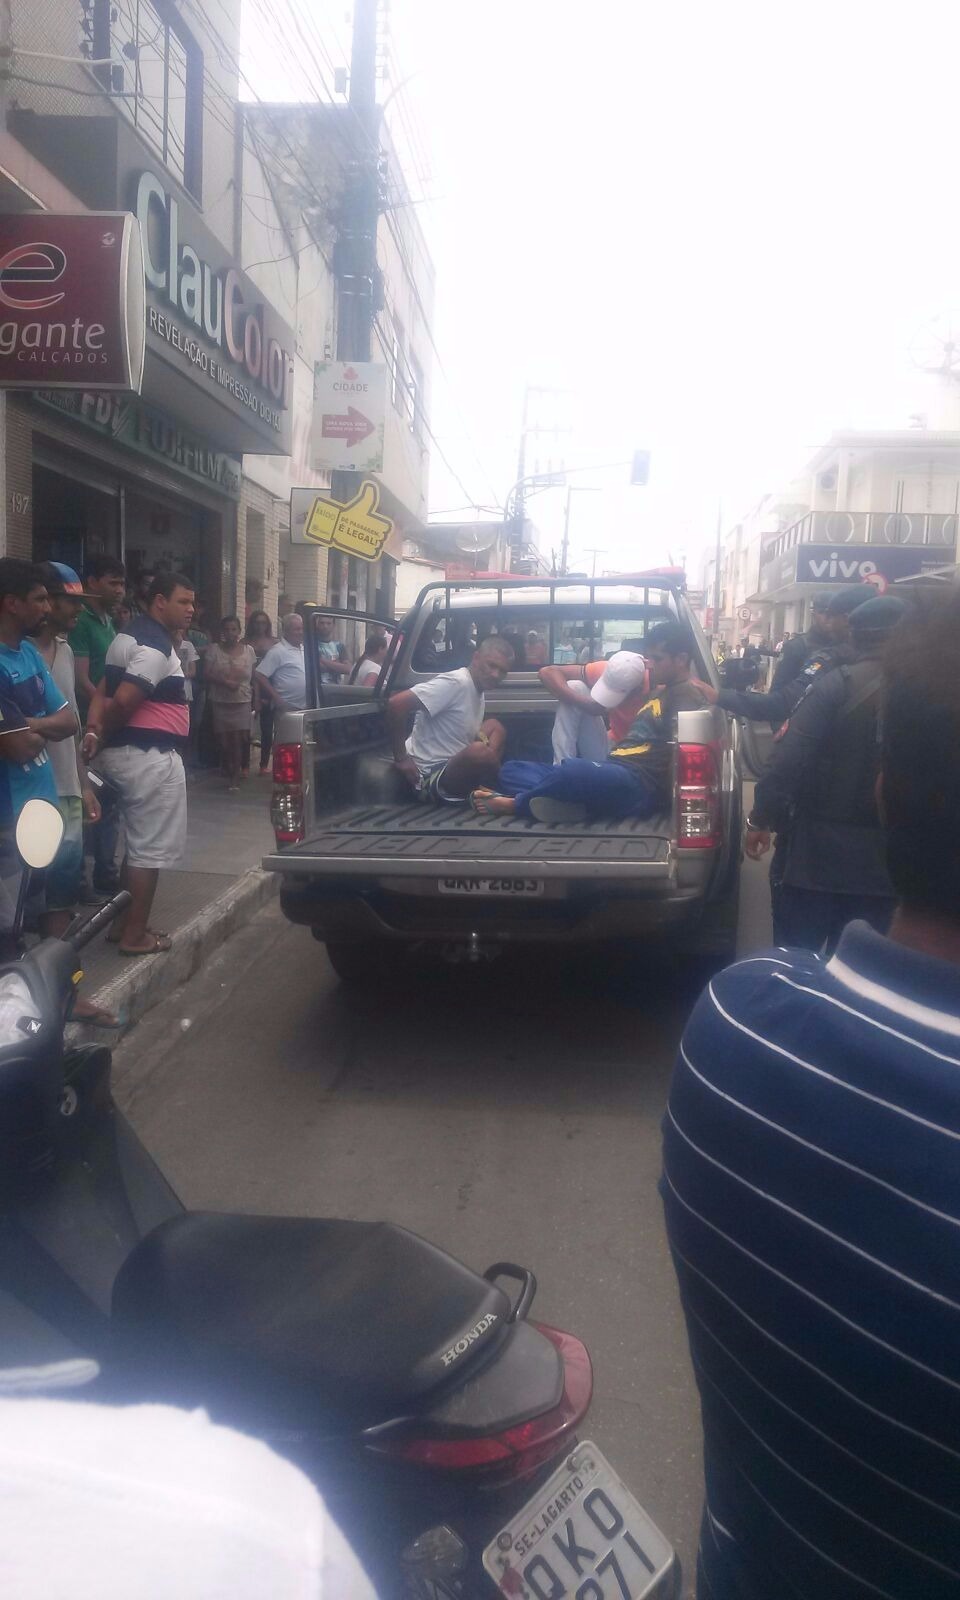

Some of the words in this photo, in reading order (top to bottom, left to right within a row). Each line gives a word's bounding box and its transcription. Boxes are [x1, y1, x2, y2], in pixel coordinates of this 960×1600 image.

[136, 171, 290, 411] ClauColor
[17, 351, 108, 364] CALÇADOS
[210, 359, 216, 378] E
[333, 382, 369, 392] CIDADE
[338, 522, 346, 533] É
[346, 527, 379, 547] LEGAL!
[808, 552, 877, 578] vivo
[441, 1313, 497, 1367] HONDA
